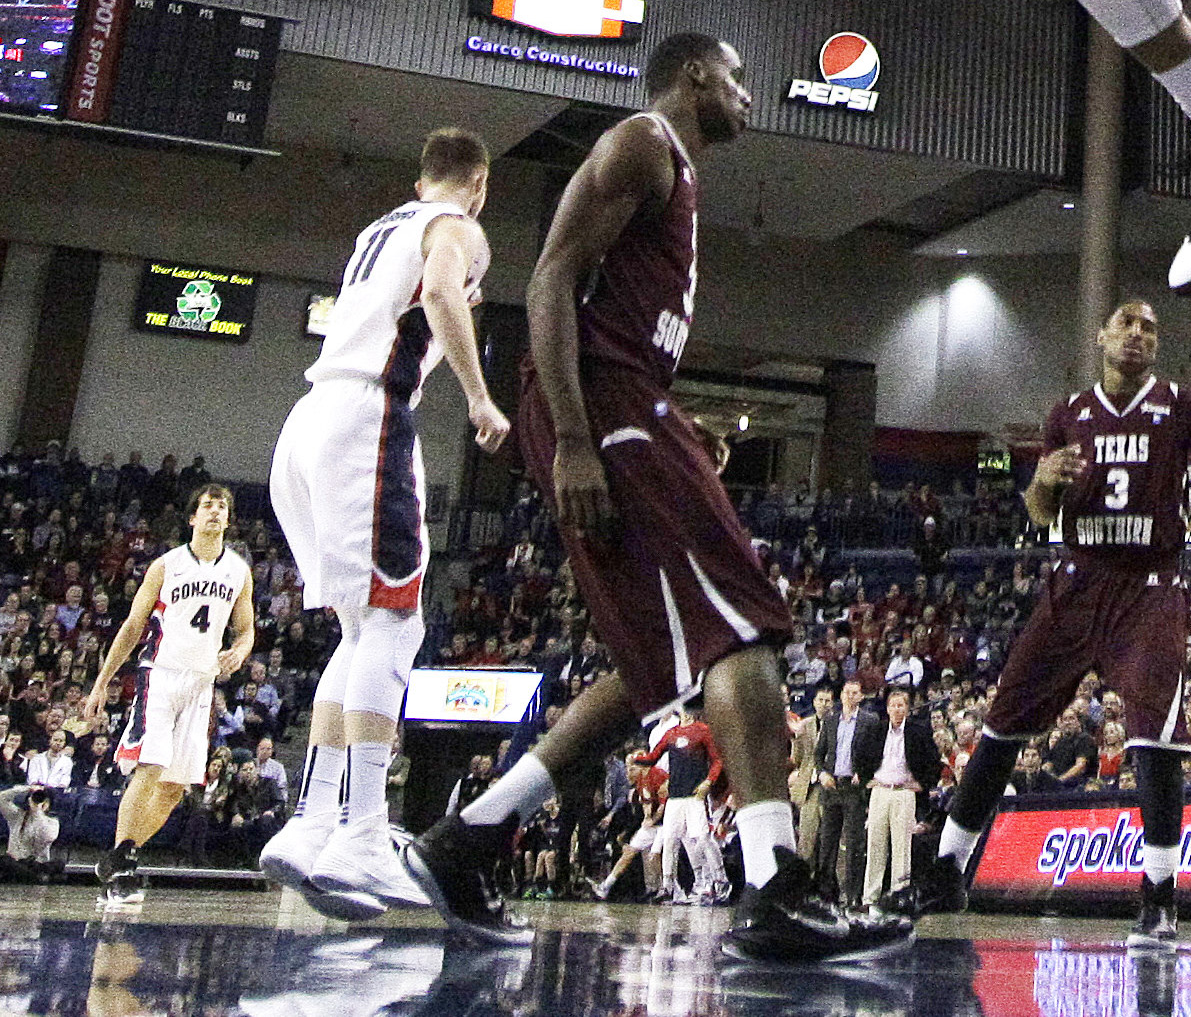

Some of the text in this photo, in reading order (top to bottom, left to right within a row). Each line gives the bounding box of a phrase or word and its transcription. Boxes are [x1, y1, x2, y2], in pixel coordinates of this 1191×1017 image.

[78, 37, 105, 110] SPORTS
[525, 45, 641, 79] Construction
[788, 78, 880, 113] PEPSI
[348, 225, 400, 287] 11
[151, 264, 173, 275] Your
[171, 266, 200, 279] Local
[199, 270, 229, 282] Phone
[145, 312, 170, 327] THE
[1094, 434, 1150, 464] TEXAS
[1104, 468, 1130, 510] 3
[171, 580, 234, 605] GONZAGA
[189, 604, 211, 634] 4
